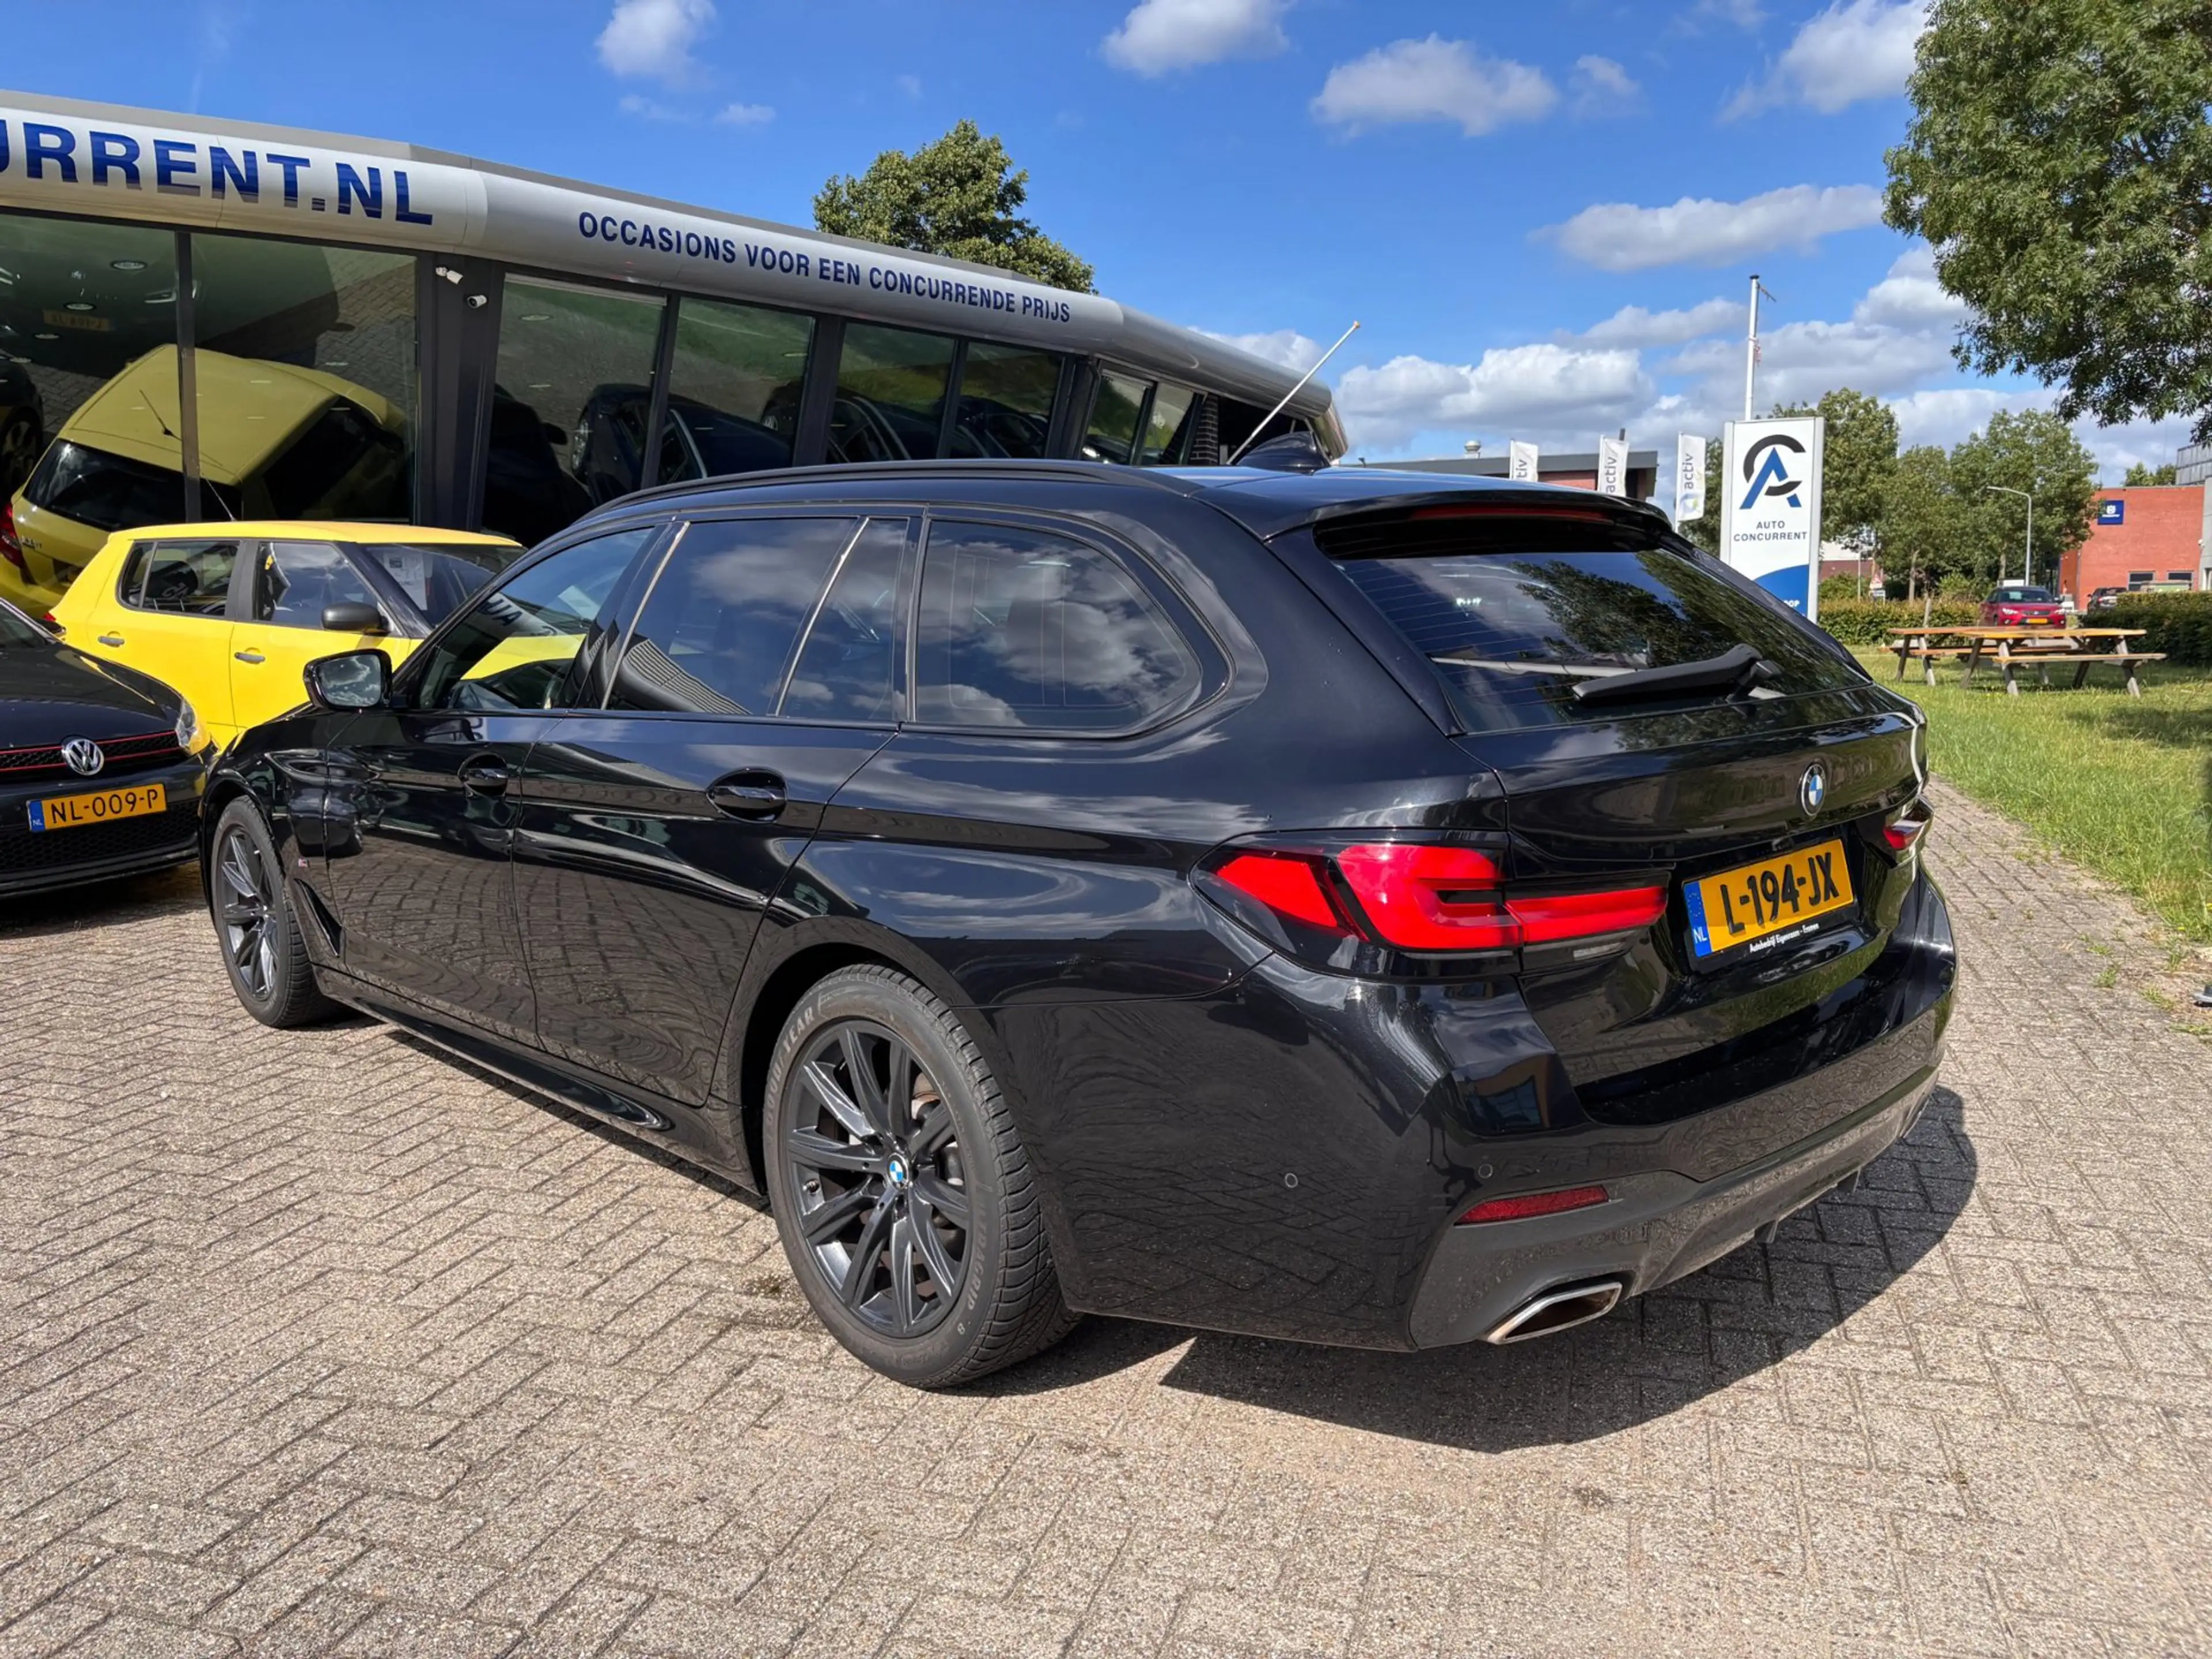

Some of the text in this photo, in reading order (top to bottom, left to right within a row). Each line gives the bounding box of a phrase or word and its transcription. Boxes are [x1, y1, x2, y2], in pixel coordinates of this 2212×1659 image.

[0, 119, 433, 225] RRENT.NL
[579, 212, 1070, 323] OCCASIONS VOOR EEN CONCURRENDE PRIJS
[1516, 459, 1527, 478] tiv
[1605, 456, 1617, 494] activ
[1682, 453, 1694, 490] activ
[1734, 532, 1807, 541] CONCURRENT
[1756, 521, 1785, 529] AUTO
[51, 789, 158, 824] NL-009-P
[1720, 852, 1840, 935] L-194-JX
[1693, 928, 1707, 944] NL
